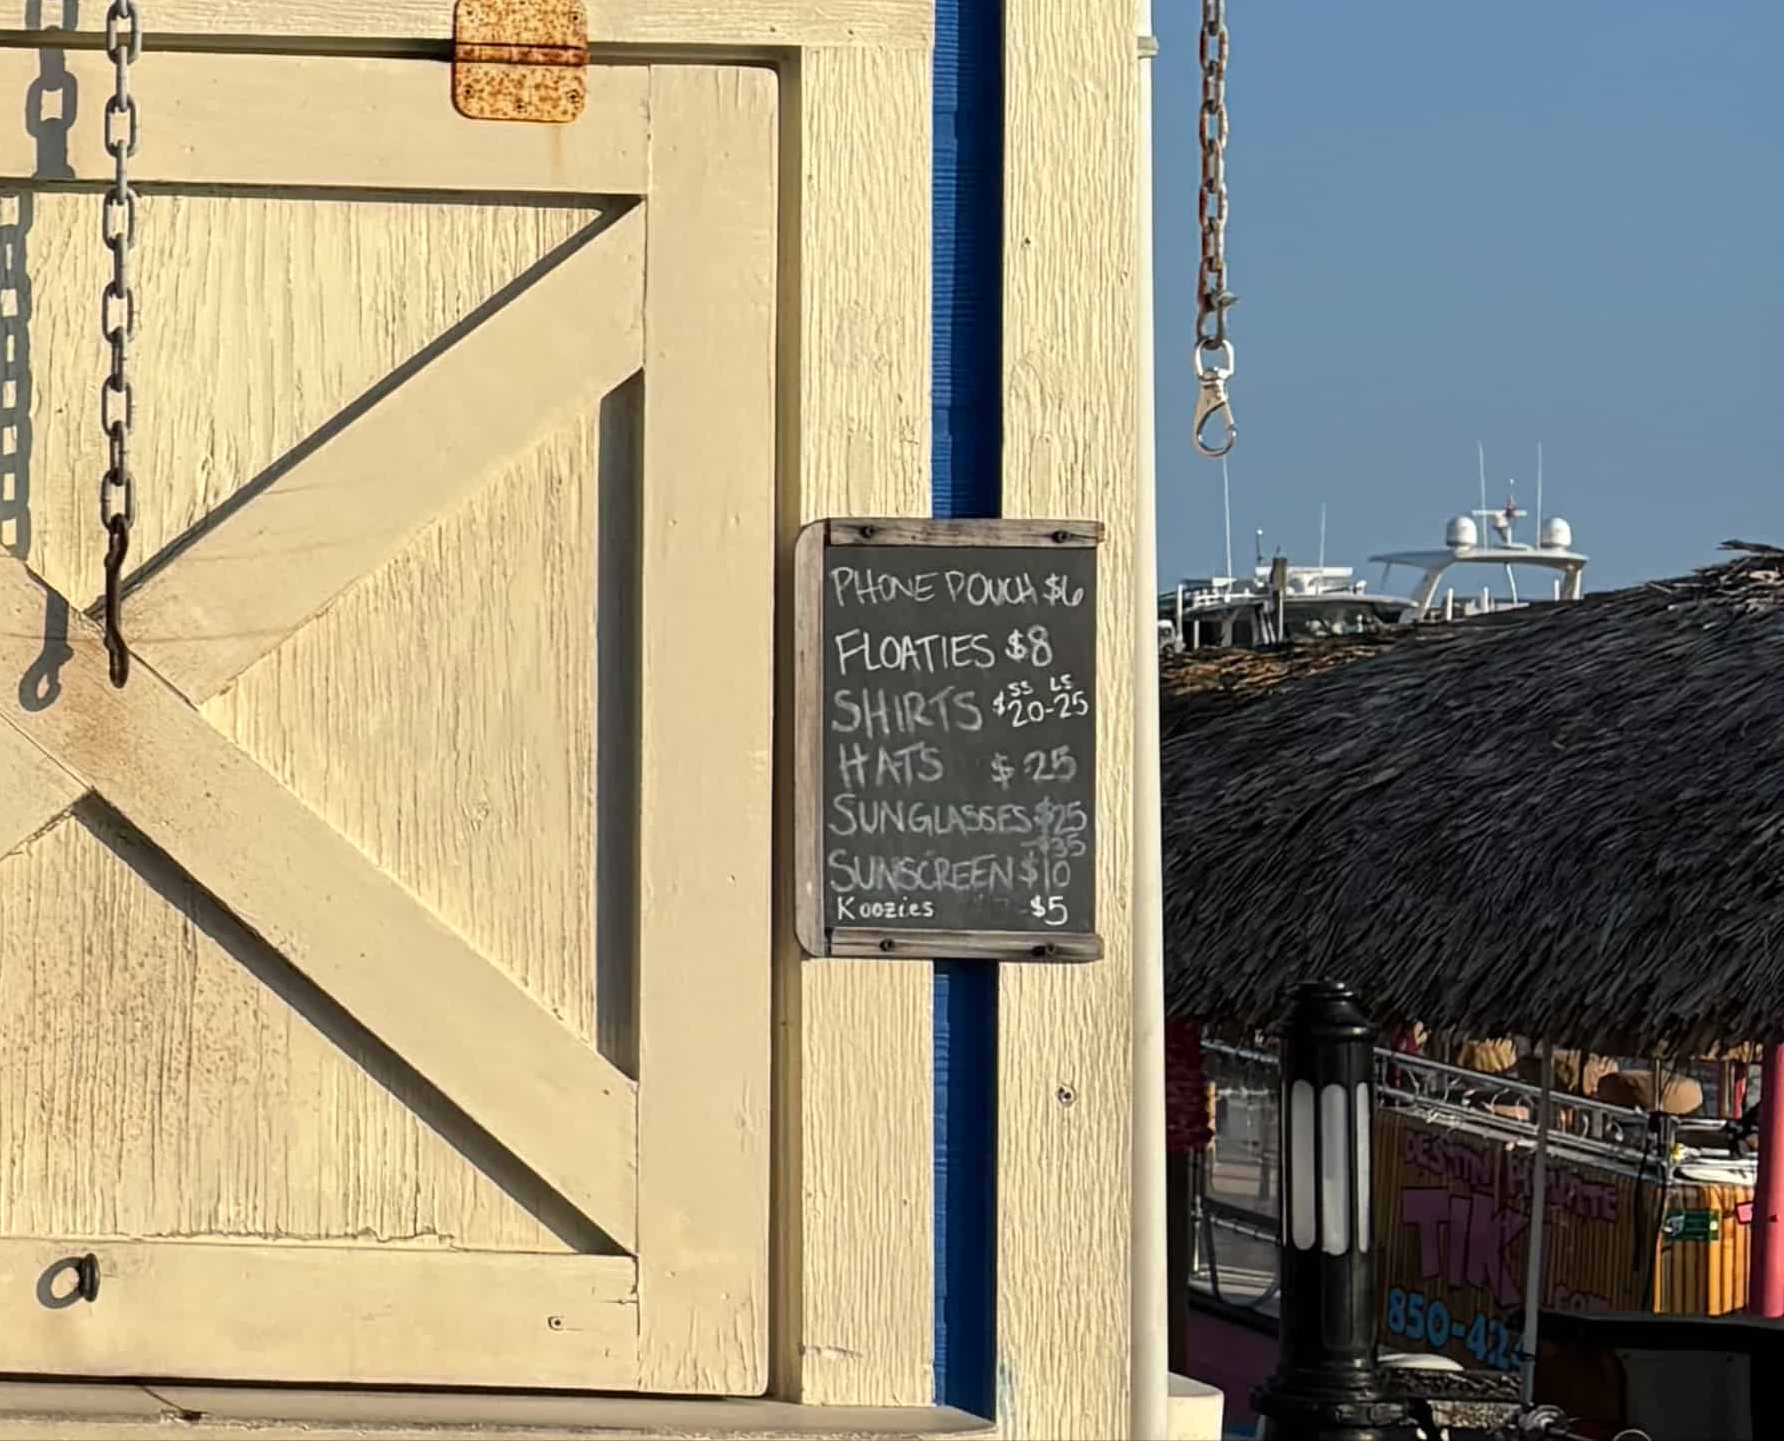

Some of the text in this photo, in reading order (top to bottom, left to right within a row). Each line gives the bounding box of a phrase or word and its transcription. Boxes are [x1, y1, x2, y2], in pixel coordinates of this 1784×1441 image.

[829, 566, 1084, 607] PHONE POUCH $6
[834, 624, 1053, 676] FLOATIES $8
[830, 685, 983, 739] SHIRTS
[838, 740, 944, 790] HATS
[828, 793, 1034, 836] SUNGLASSES
[827, 848, 1072, 894] SUNSCREEN $10
[837, 894, 1069, 926] Koozies $5
